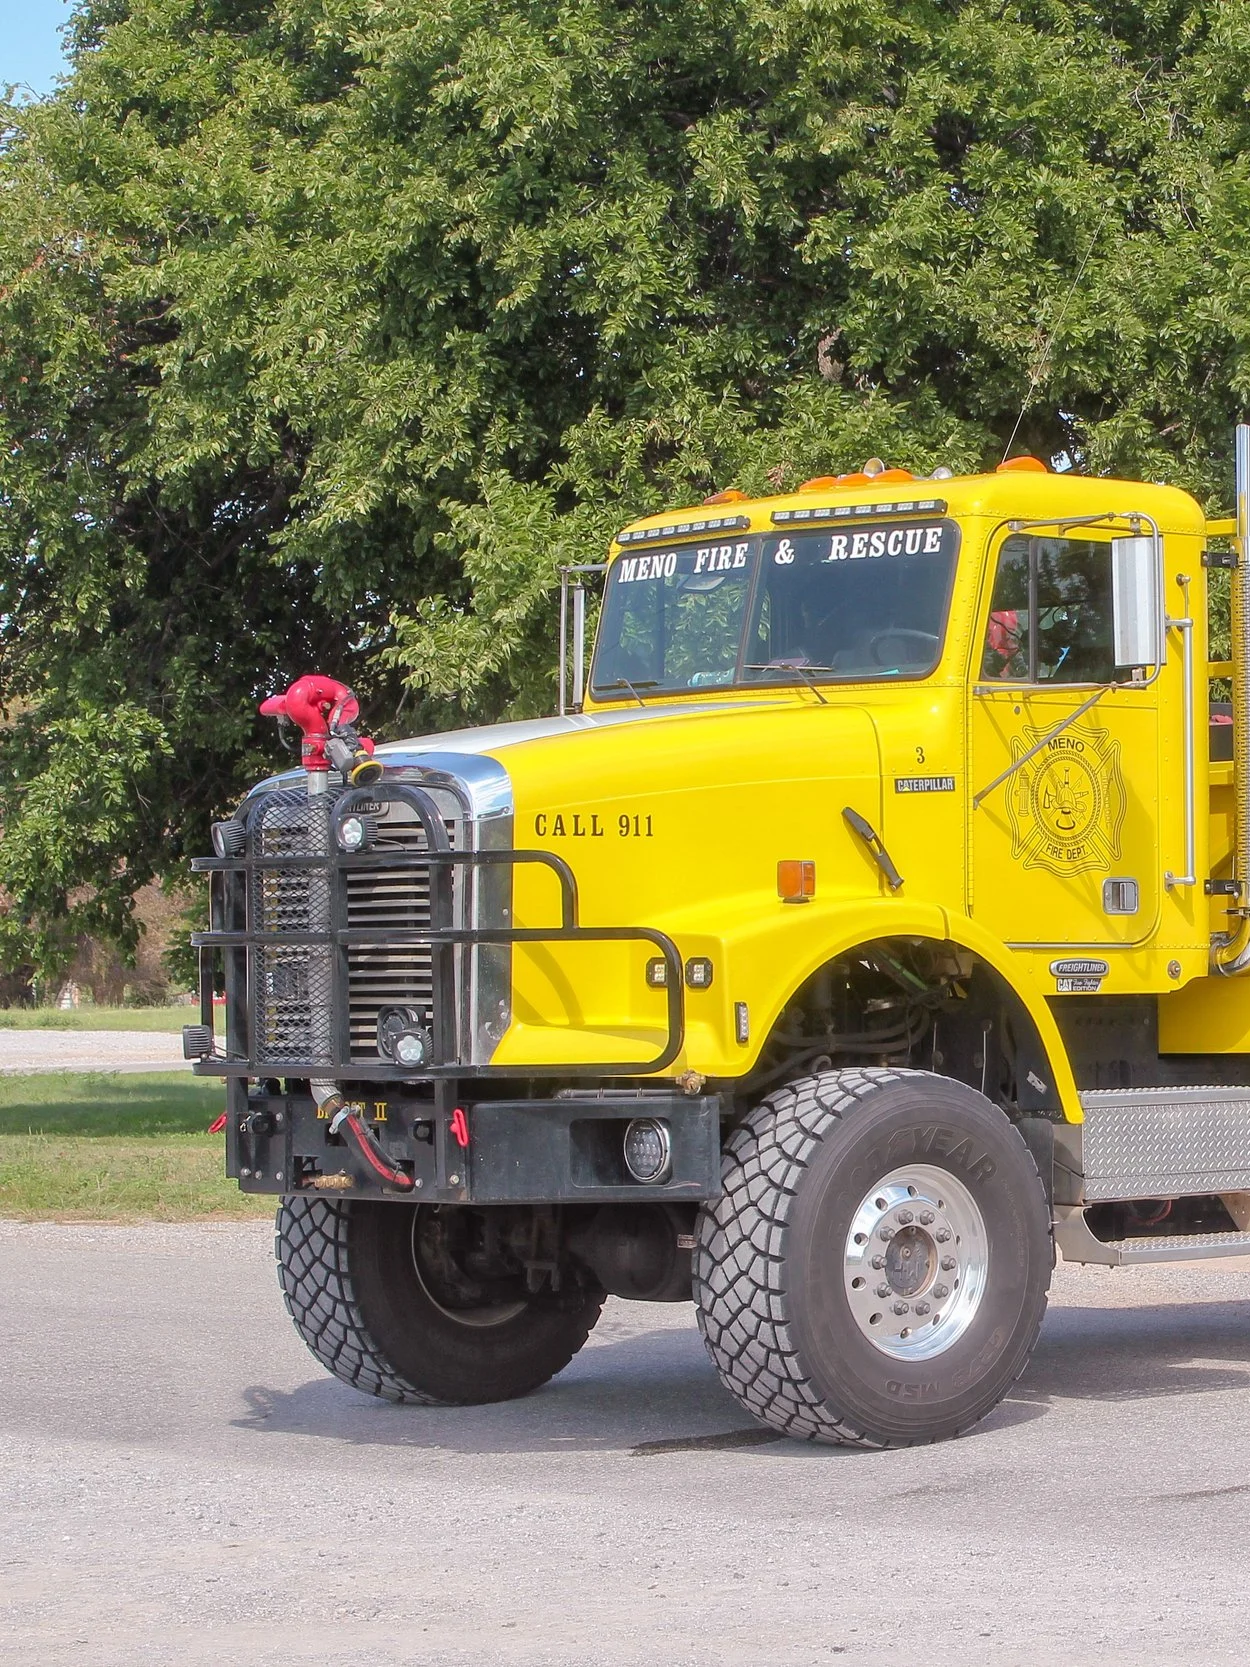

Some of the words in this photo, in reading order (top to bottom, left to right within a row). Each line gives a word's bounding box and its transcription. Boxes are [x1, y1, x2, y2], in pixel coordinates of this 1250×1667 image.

[618, 552, 677, 584] MENO
[693, 542, 749, 574] FIRE
[774, 538, 795, 565] &
[828, 526, 943, 561] RESCUE
[1047, 737, 1085, 753] MENO
[915, 746, 926, 764] 3
[897, 777, 954, 792] CATERPILLAR
[534, 813, 604, 837] CALL
[618, 814, 654, 837] 911
[1045, 843, 1063, 860] FIRE
[1066, 845, 1089, 860] DEPT.
[1058, 962, 1105, 972] FREIGHTLINER
[1057, 978, 1073, 992] CAT
